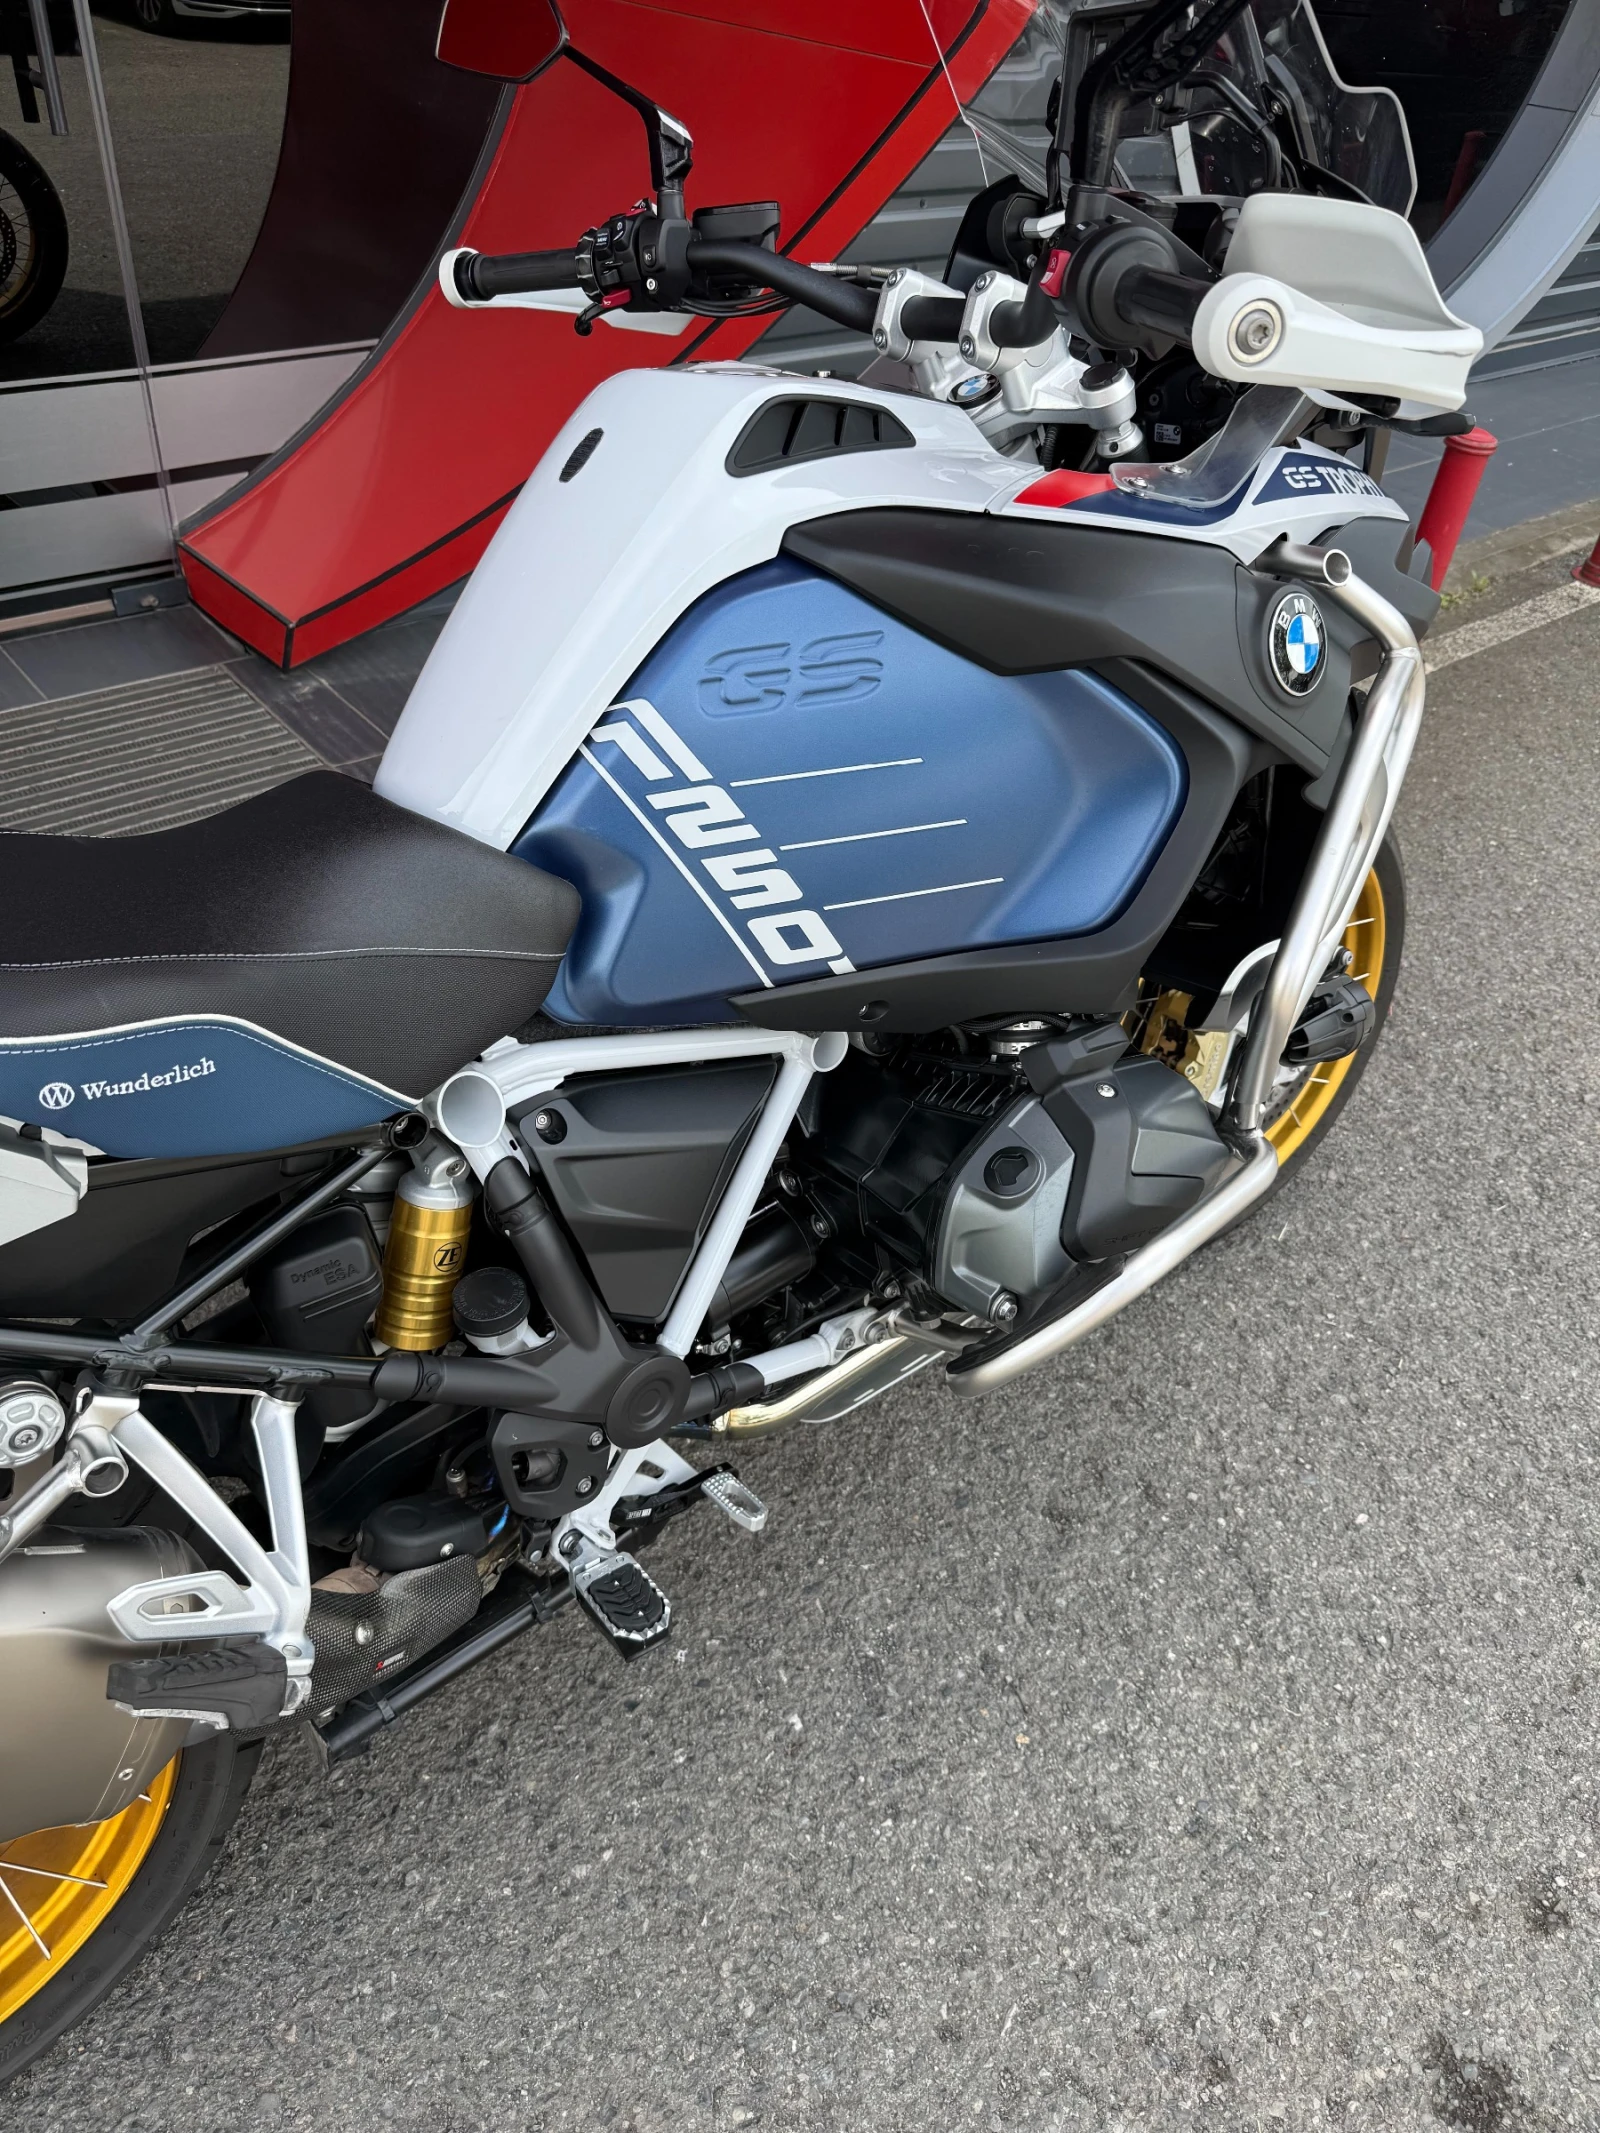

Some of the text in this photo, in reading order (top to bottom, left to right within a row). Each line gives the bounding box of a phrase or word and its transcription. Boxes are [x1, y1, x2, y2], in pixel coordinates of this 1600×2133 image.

[1282, 466, 1322, 489] GS
[1278, 598, 1322, 630] BMW
[697, 629, 885, 718] GS
[81, 1056, 216, 1101] Wunderlich
[436, 1246, 461, 1268] ZF
[290, 1258, 342, 1284] Dynamic
[324, 1262, 361, 1286] ESA
